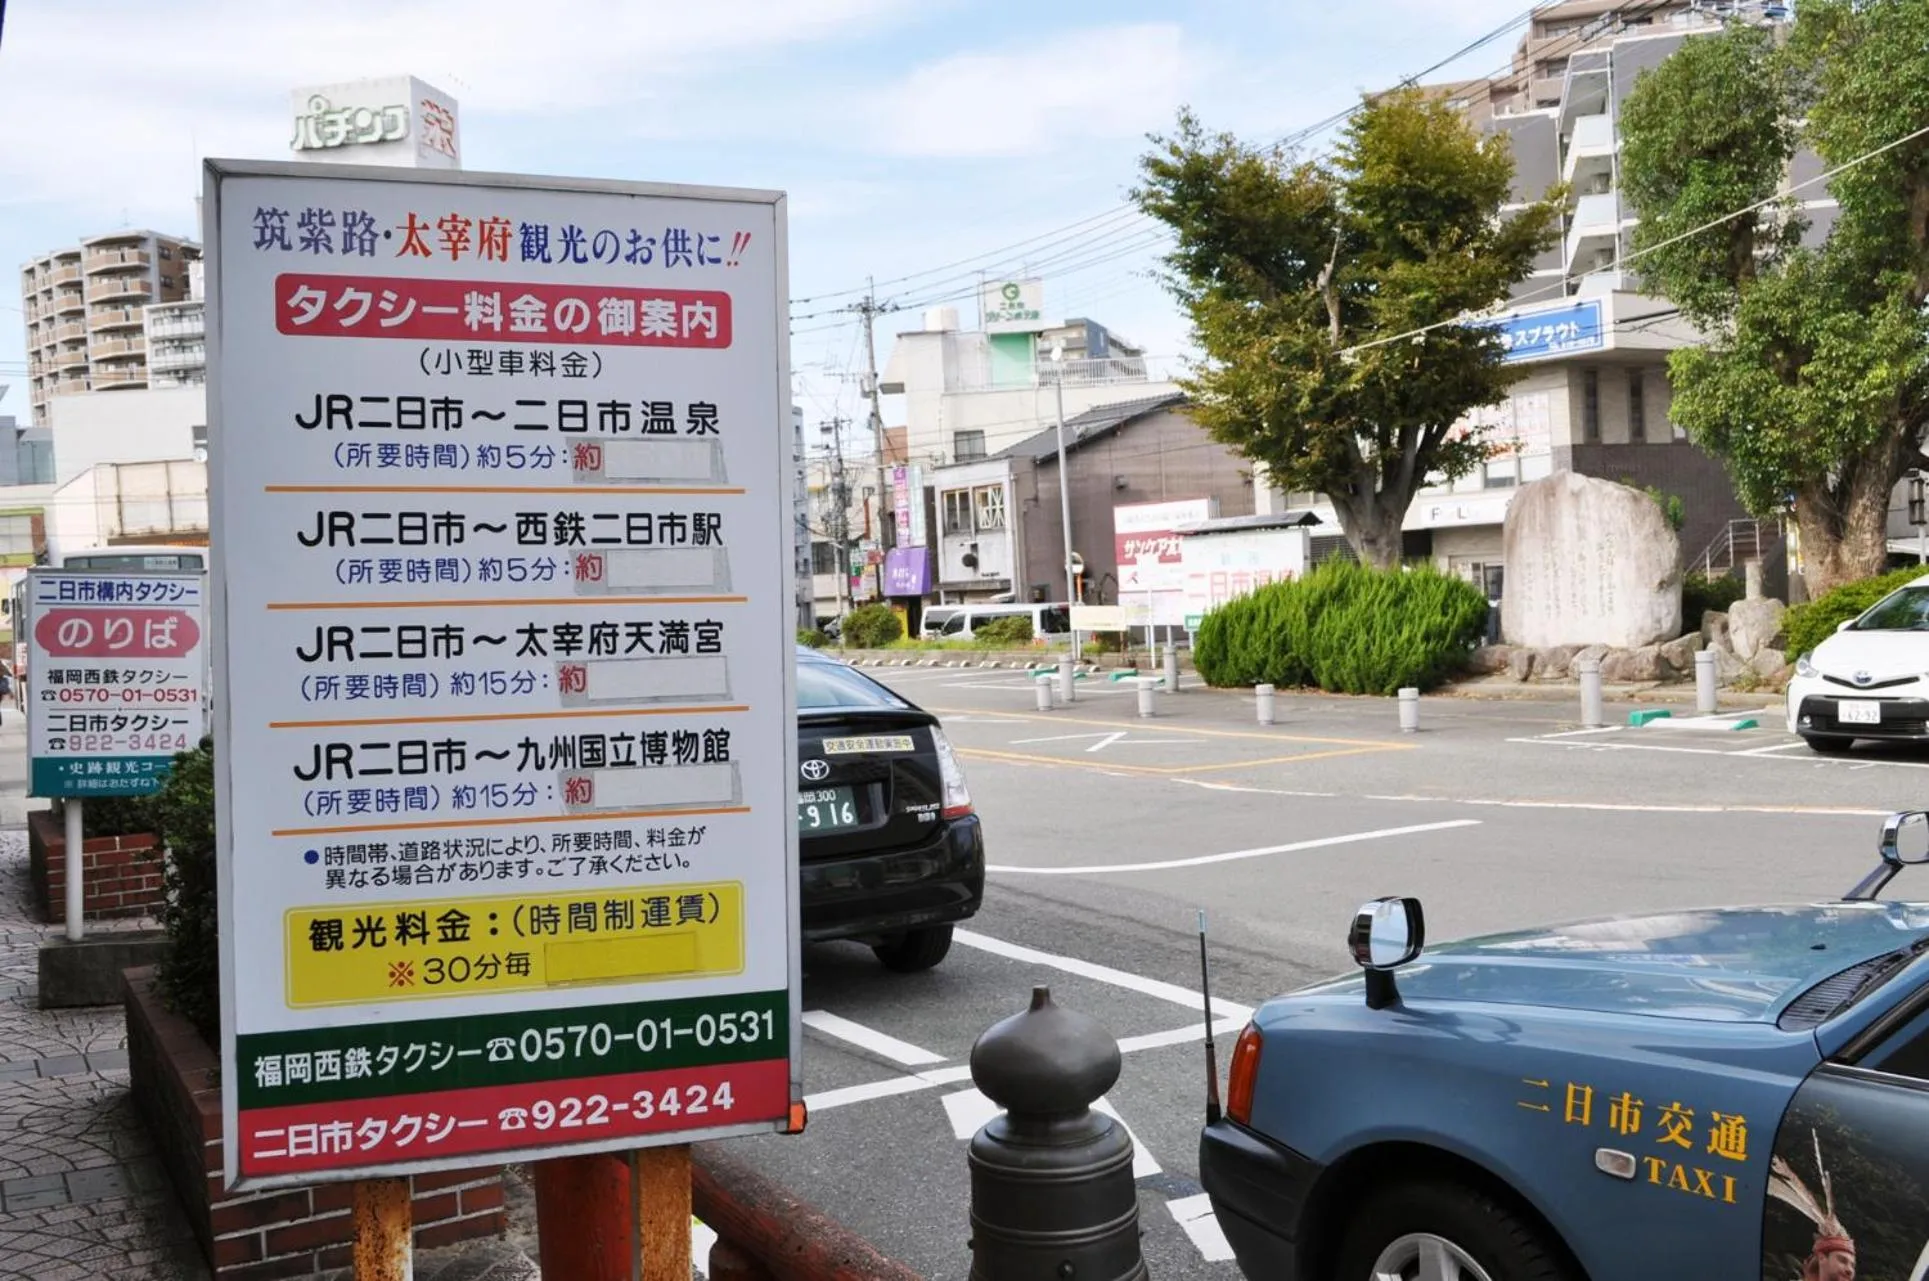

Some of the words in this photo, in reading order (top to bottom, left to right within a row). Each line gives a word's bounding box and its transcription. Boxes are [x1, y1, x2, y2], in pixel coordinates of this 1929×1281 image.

[286, 290, 719, 339] タクシー料金の御案内
[420, 348, 603, 379] (小型車料金)
[38, 580, 198, 602] 二日市構内タクシー
[58, 616, 178, 650] のりば
[47, 669, 188, 685] 福岡西鉄タクシー
[59, 688, 197, 703] 0570-01-0531
[47, 714, 188, 733] 二日市タクシー
[69, 733, 187, 751] 922-3424
[325, 857, 692, 890] 異なる場合があります。ご了承ください。
[254, 1039, 482, 1088] 福岡西鉄タクシー
[520, 1009, 775, 1064] 0570-01-0531
[253, 1116, 488, 1160] 二日市タクシー
[532, 1081, 735, 1129] 922-3424
[1516, 1077, 1748, 1161] 二日市交通
[1643, 1156, 1737, 1204] TAXI
